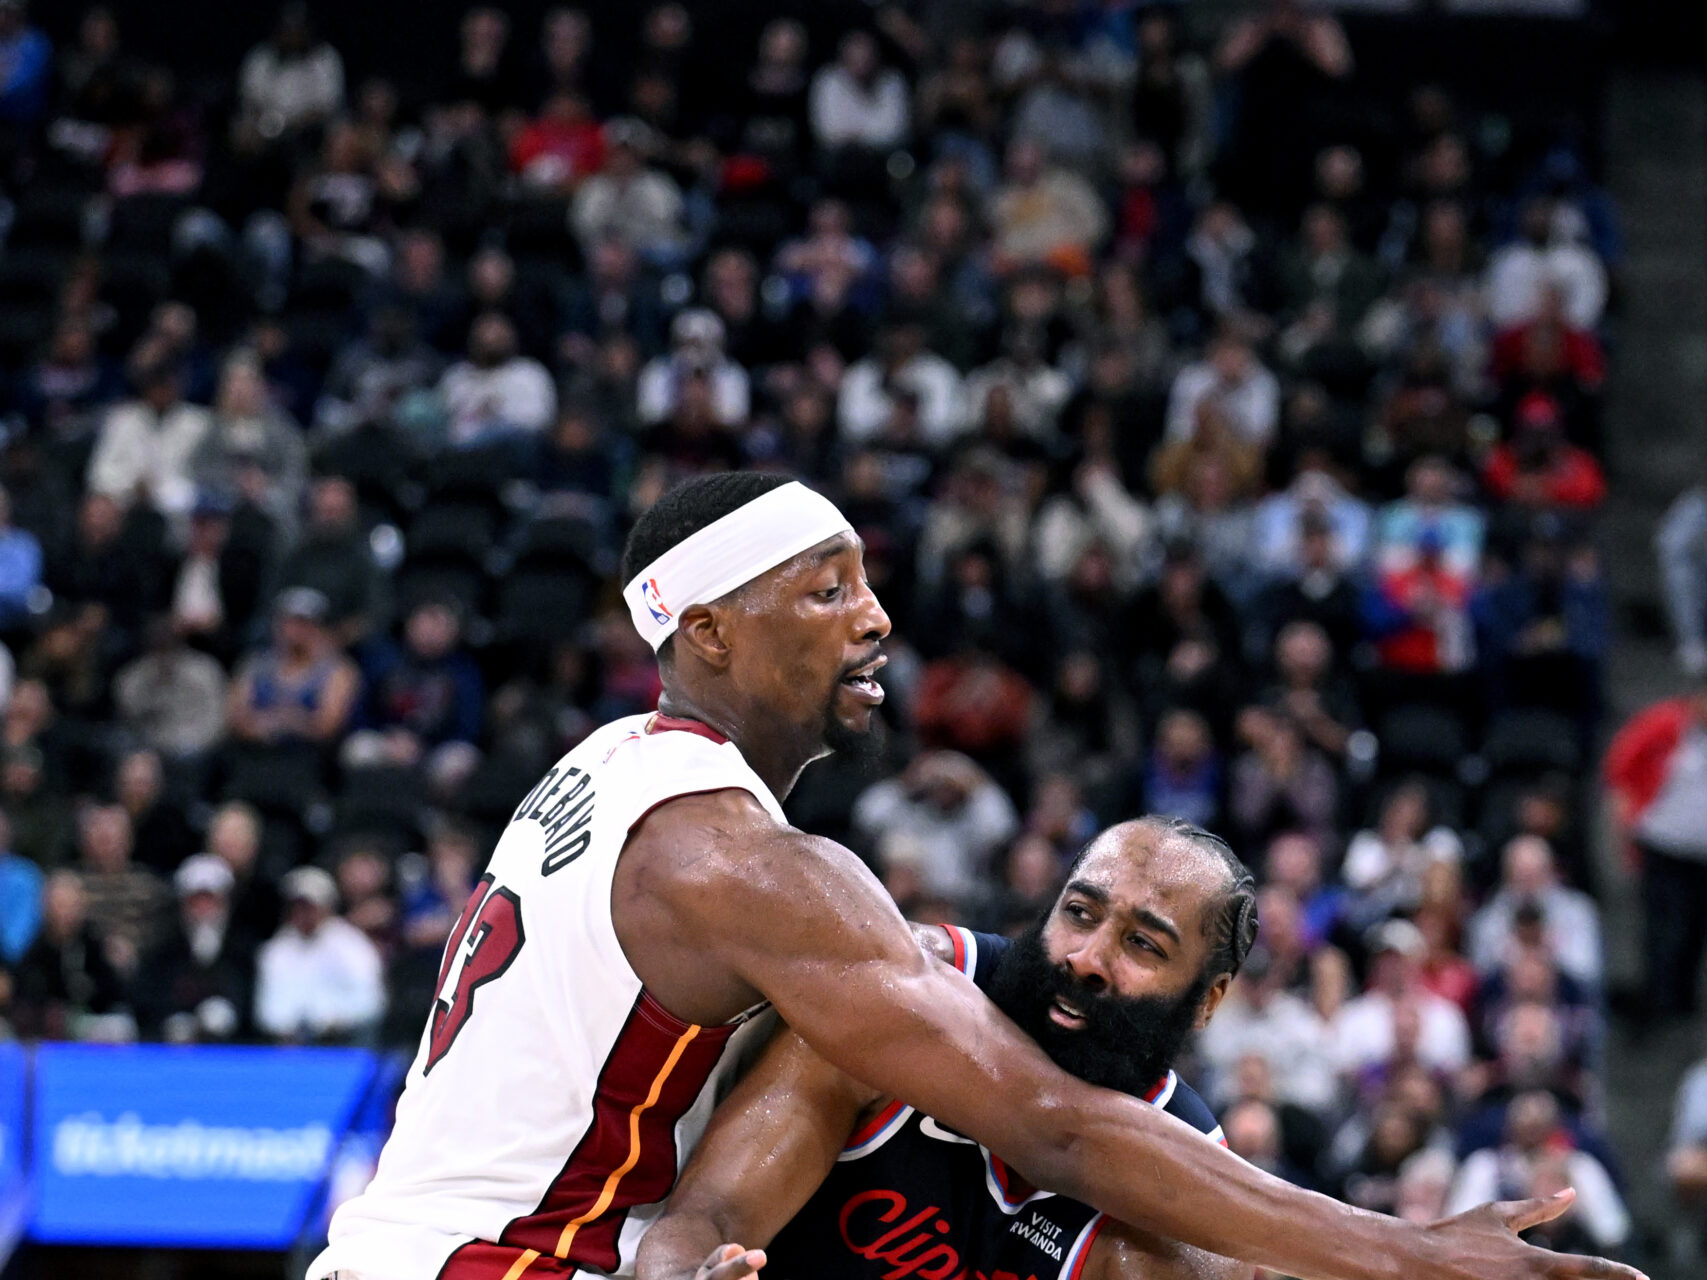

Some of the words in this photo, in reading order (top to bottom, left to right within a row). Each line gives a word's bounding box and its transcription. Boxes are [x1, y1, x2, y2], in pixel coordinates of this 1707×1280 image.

[513, 766, 596, 877] DEBAYO
[1010, 1221, 1062, 1261] RWANDA
[1031, 1211, 1062, 1240] VISIT
